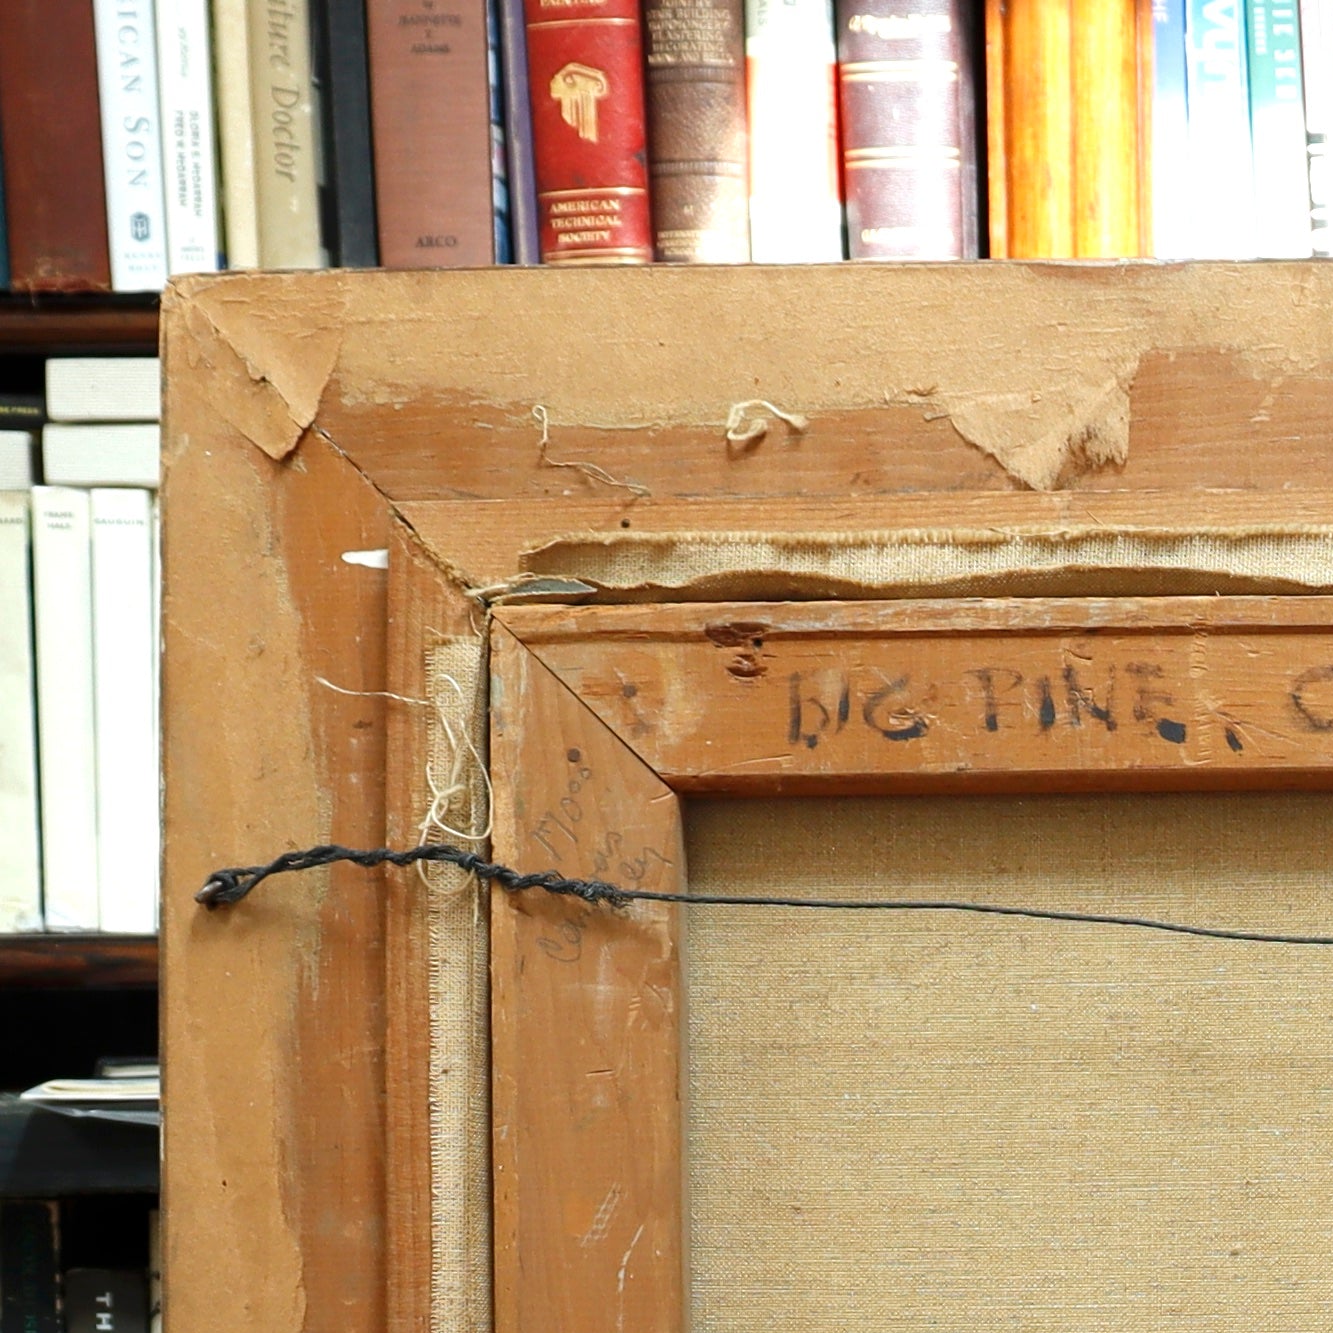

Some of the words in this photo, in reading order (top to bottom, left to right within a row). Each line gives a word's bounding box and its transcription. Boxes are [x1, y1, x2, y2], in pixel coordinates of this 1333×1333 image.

[116, 0, 142, 94] ICAN
[271, 86, 301, 183] Doctor
[123, 115, 150, 188] SON
[549, 199, 621, 213] AMERICAN
[551, 215, 622, 229] TECHNICAL
[416, 235, 457, 248] ARCO
[557, 230, 612, 244] SOCIETY
